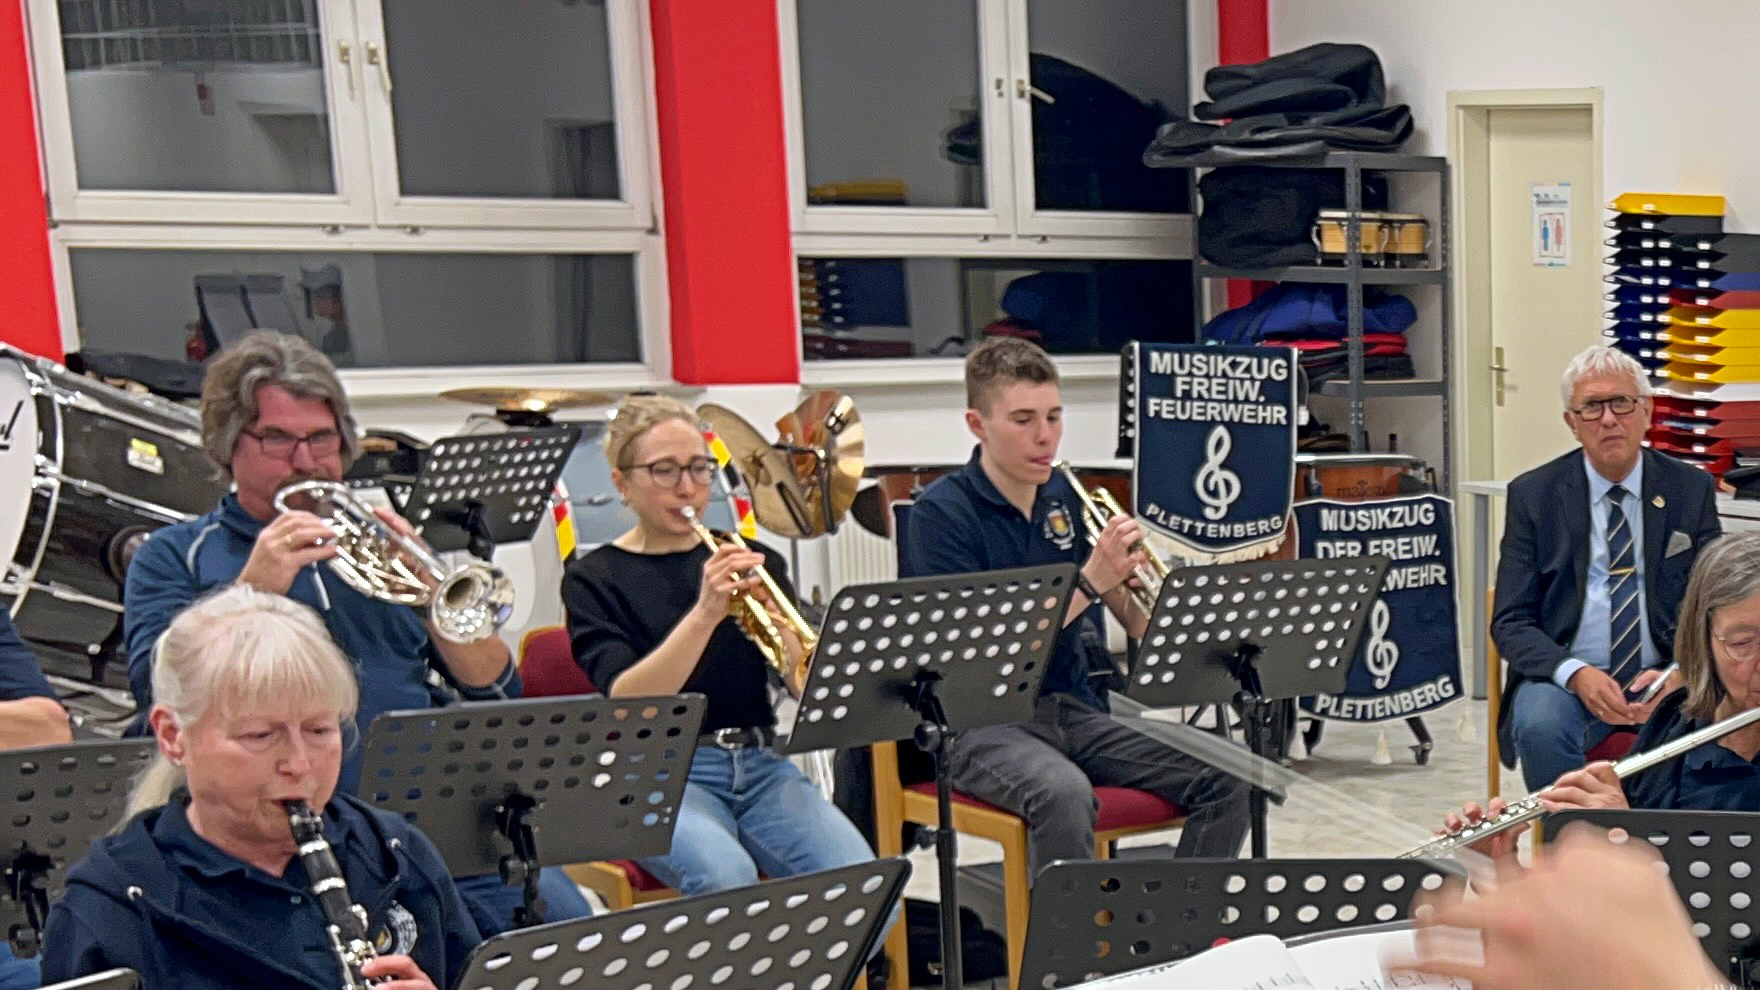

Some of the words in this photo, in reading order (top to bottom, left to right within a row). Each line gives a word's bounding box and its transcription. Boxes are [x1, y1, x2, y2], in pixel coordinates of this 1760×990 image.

[1150, 351, 1288, 381] MUSIKZUG
[1174, 376, 1266, 402] FREIW.
[1147, 398, 1288, 425] FEUERWEHR
[1145, 502, 1283, 538] PLETTENBERG
[1319, 503, 1436, 531] MUSIKZUG
[1315, 540, 1362, 559] DER
[1368, 534, 1441, 560] FREIW.
[1314, 676, 1455, 719] PLETTENBERG
